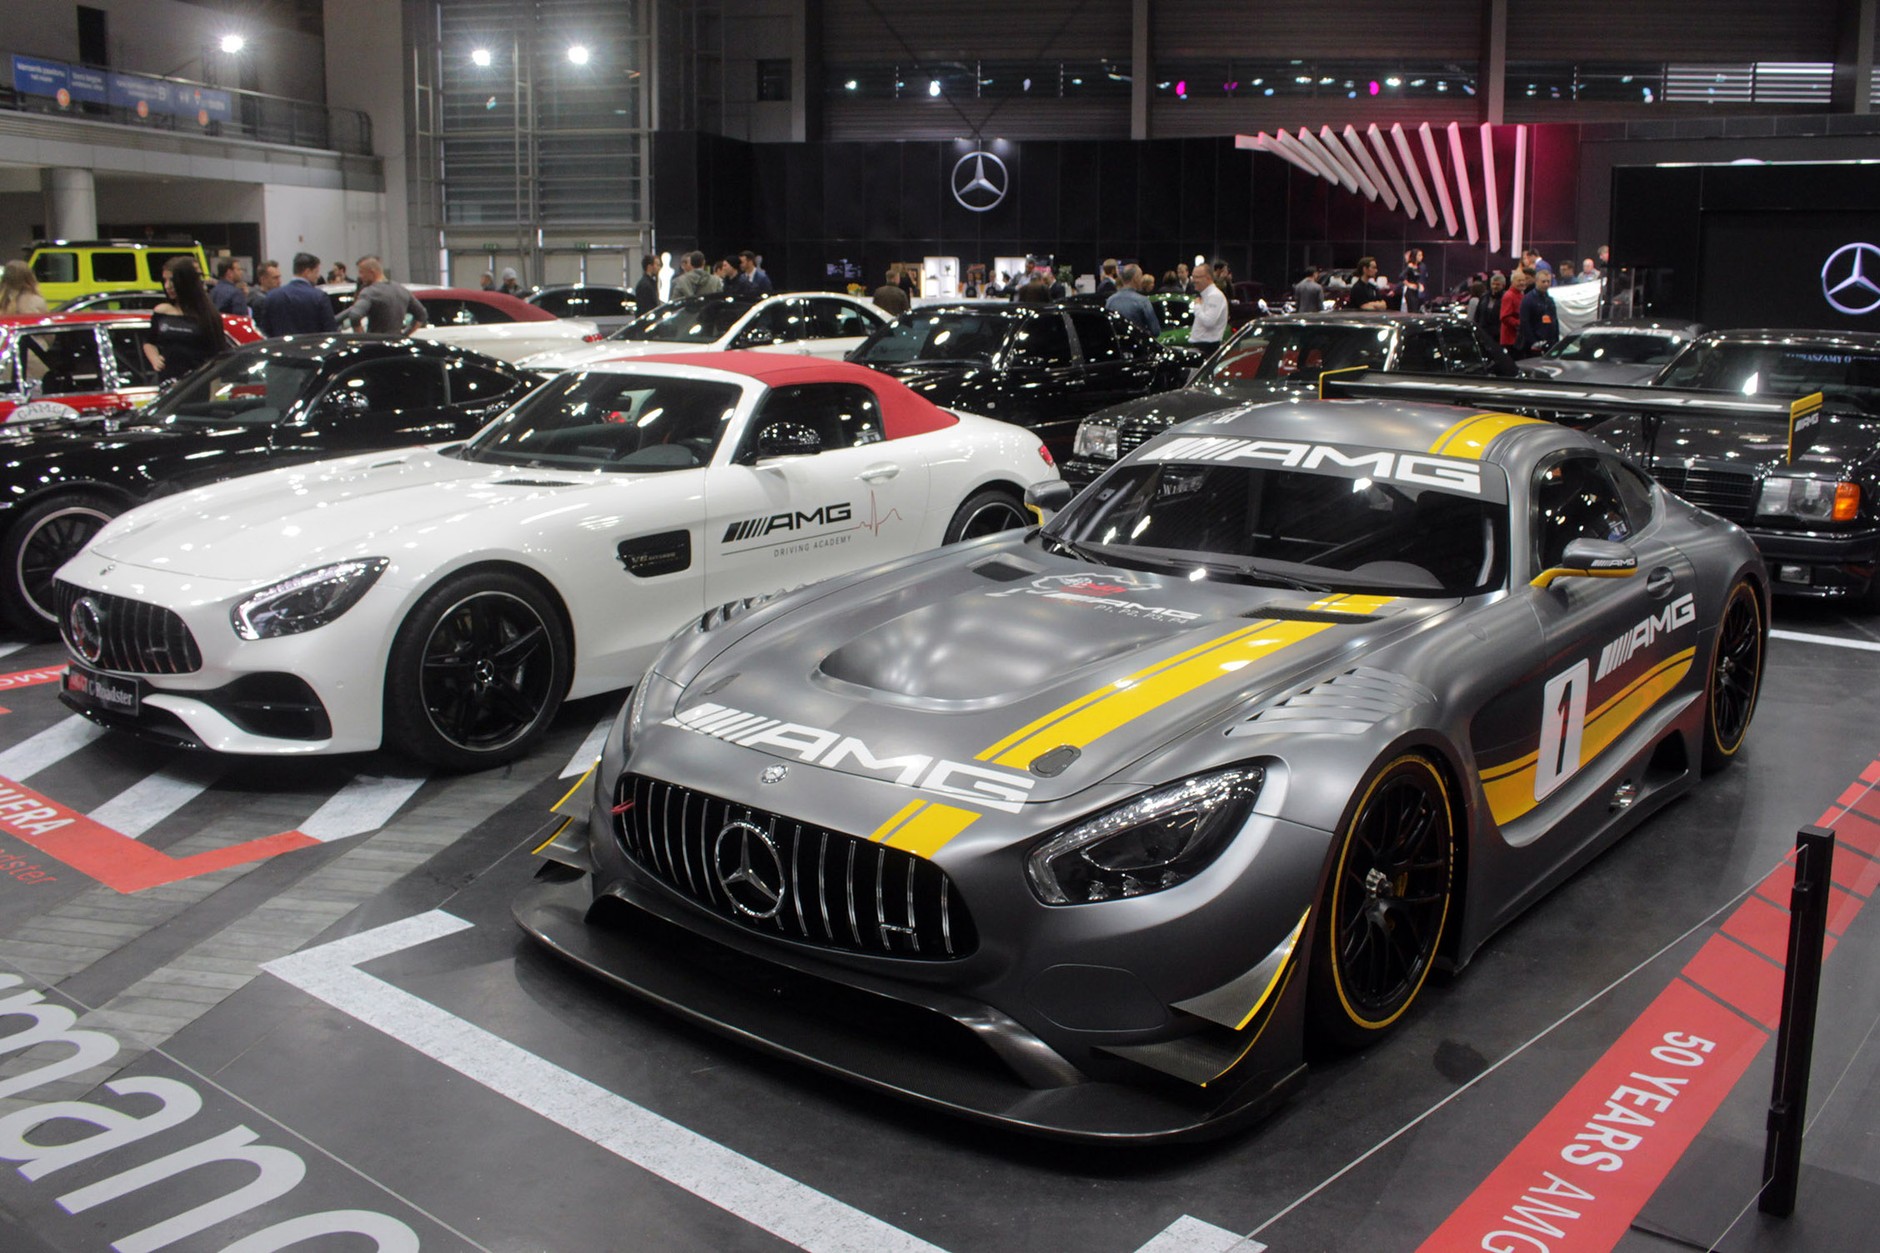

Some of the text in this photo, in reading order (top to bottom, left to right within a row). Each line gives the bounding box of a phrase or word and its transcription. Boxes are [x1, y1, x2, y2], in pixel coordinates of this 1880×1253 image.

[1215, 440, 1482, 494] AMG
[763, 502, 851, 535] AMG
[773, 534, 852, 557] DRIVING ACADEMY
[1627, 593, 1697, 660] AMG
[96, 682, 133, 706] Roadster
[1557, 680, 1574, 777] 1
[742, 722, 1036, 815] AMG
[1650, 1031, 1716, 1067] 50
[1561, 1071, 1690, 1172] YEARS
